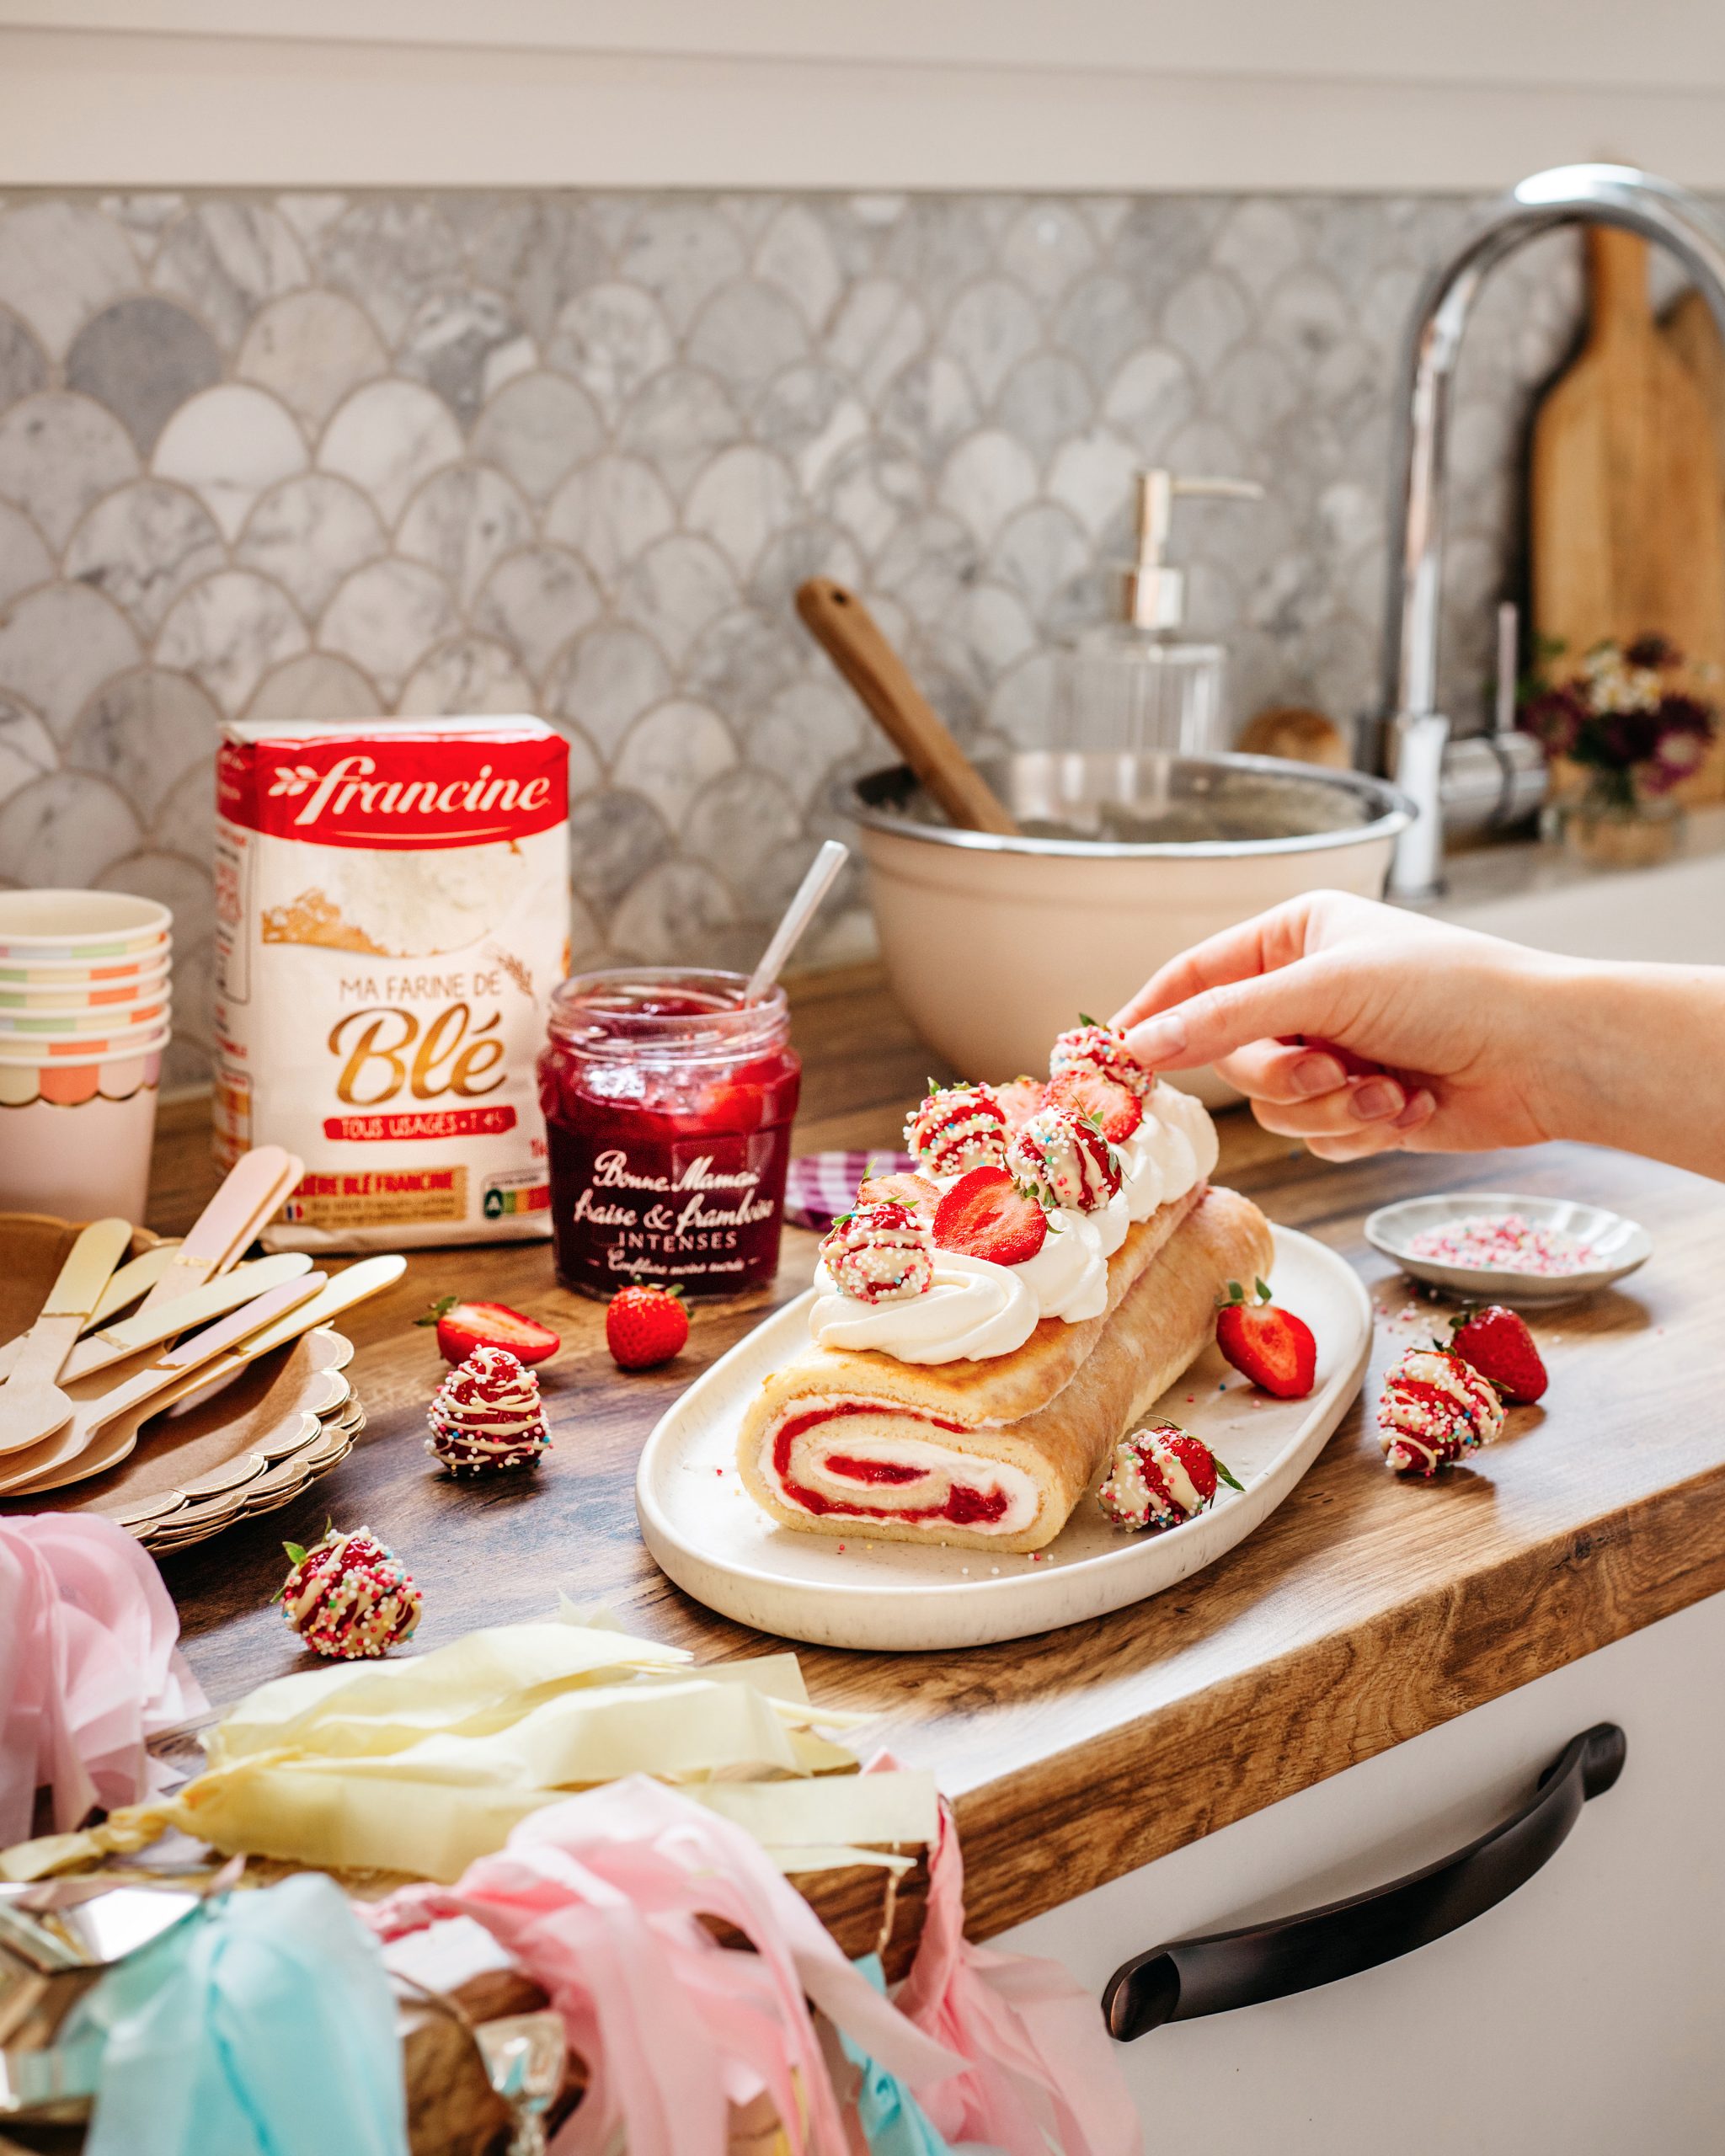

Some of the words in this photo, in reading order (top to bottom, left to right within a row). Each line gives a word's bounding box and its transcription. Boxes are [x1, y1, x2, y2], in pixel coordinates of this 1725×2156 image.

[294, 755, 552, 825] francine
[339, 976, 380, 1002] MA
[386, 972, 468, 1001] FARINE
[476, 970, 501, 997] DE
[328, 1002, 508, 1107] Blé
[342, 1117, 384, 1139] TOUS
[388, 1113, 458, 1138] USAGES
[592, 1150, 670, 1192] Bonne
[671, 1155, 760, 1193] Maman
[574, 1188, 638, 1227] fraise
[643, 1203, 674, 1230] &
[618, 1230, 738, 1253] INTENSES
